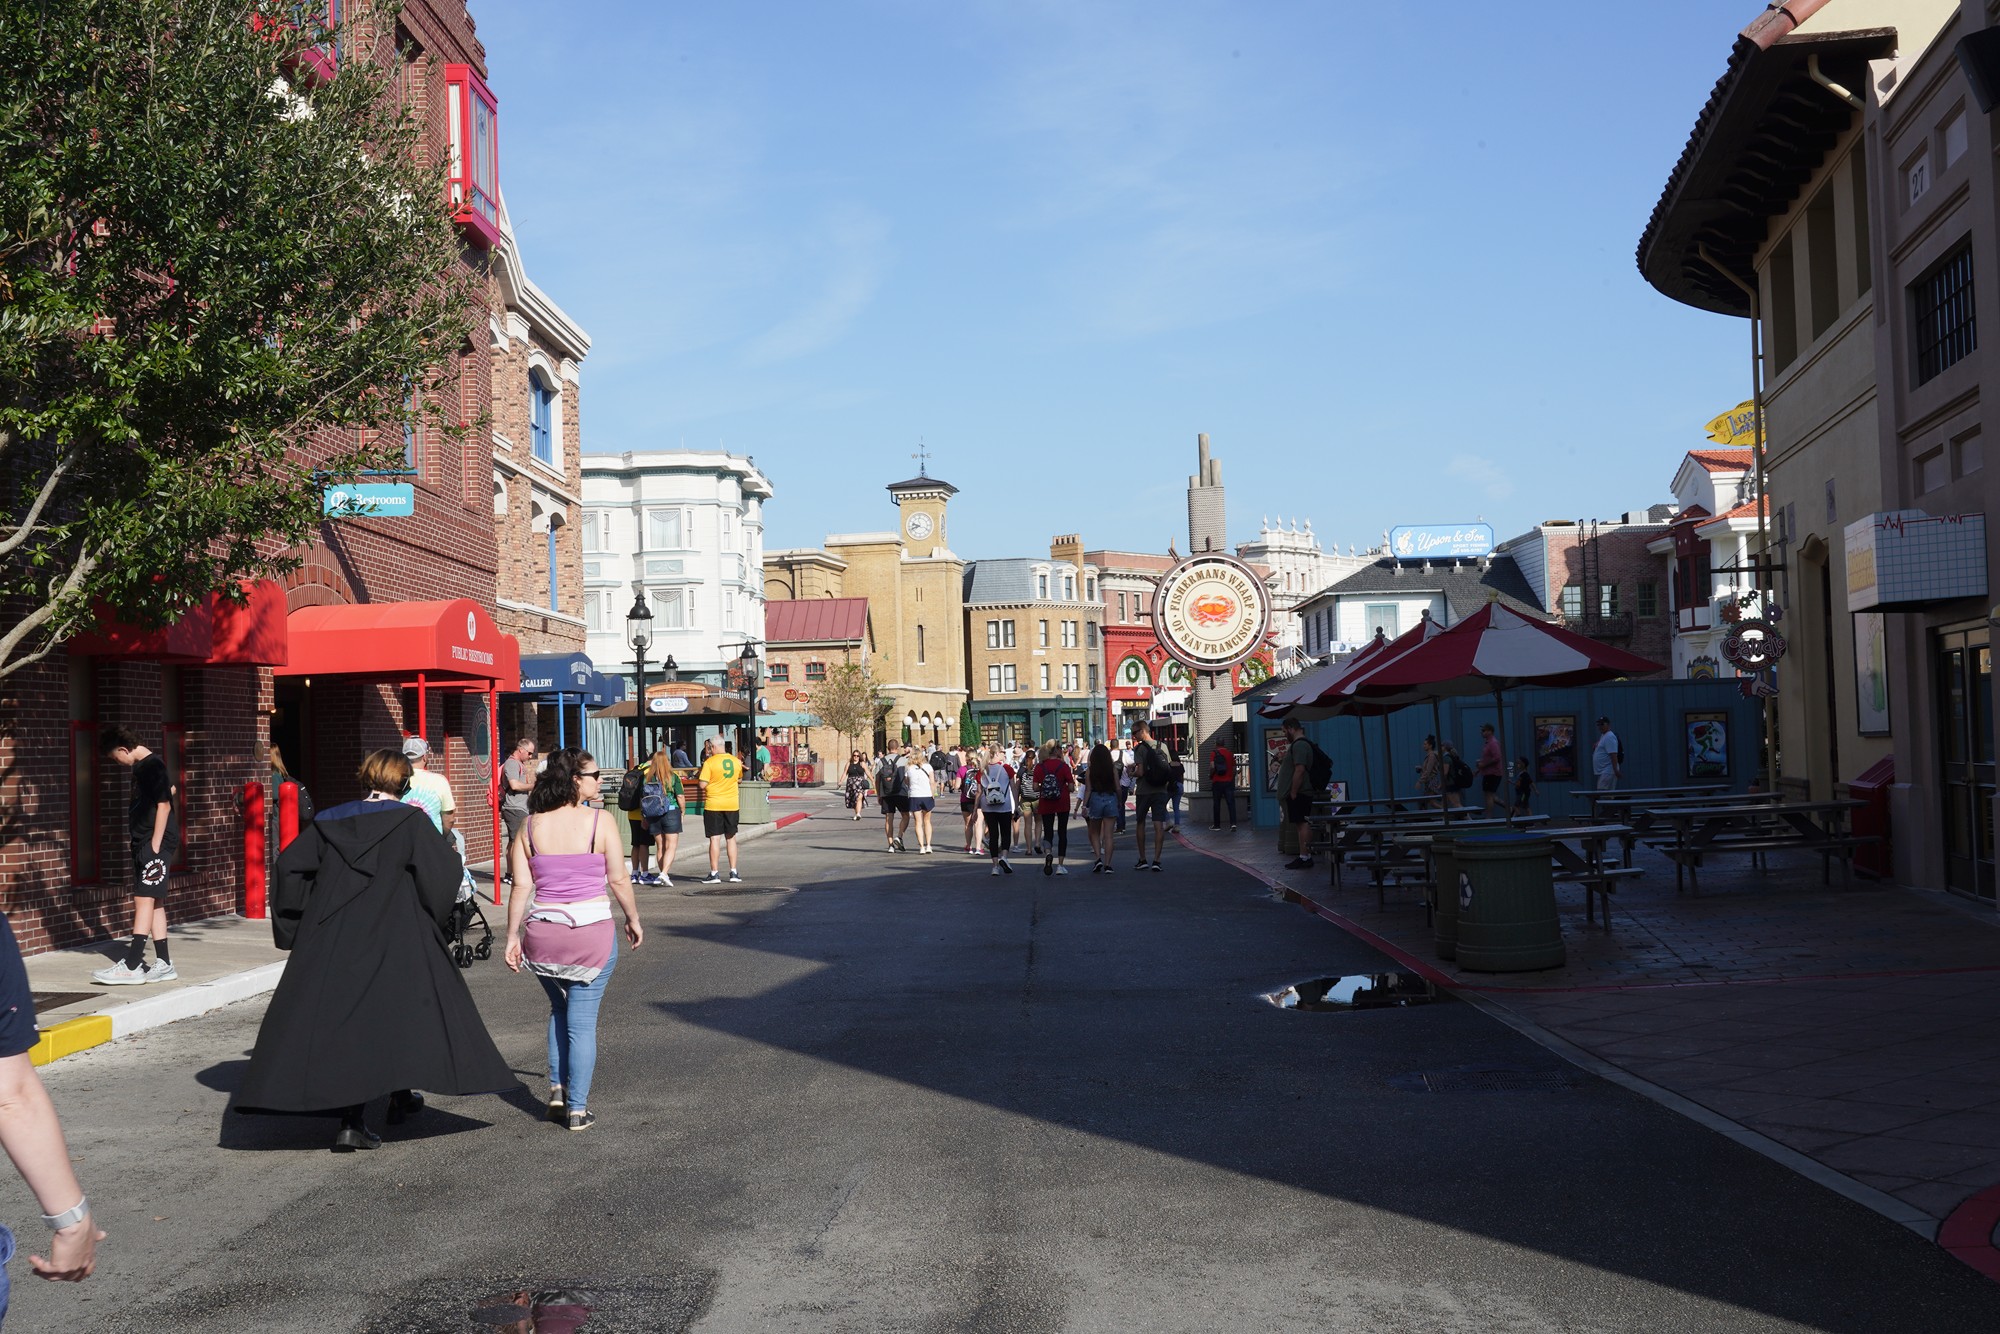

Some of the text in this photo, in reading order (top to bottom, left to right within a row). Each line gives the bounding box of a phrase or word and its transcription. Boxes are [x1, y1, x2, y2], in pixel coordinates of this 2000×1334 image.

[1912, 165, 1924, 200] 27
[355, 493, 407, 506] Restrooms
[1417, 528, 1485, 553] Upson & Son
[1170, 568, 1255, 611] FISHERMANS WHARF
[1172, 618, 1254, 654] OF SAN FRANCISCO
[1720, 633, 1787, 661] Candy
[451, 645, 494, 666] PUBLIC RESTROOMS
[1739, 657, 1770, 669] FACTORY
[525, 678, 553, 688] GALLERY
[722, 758, 735, 779] 9
